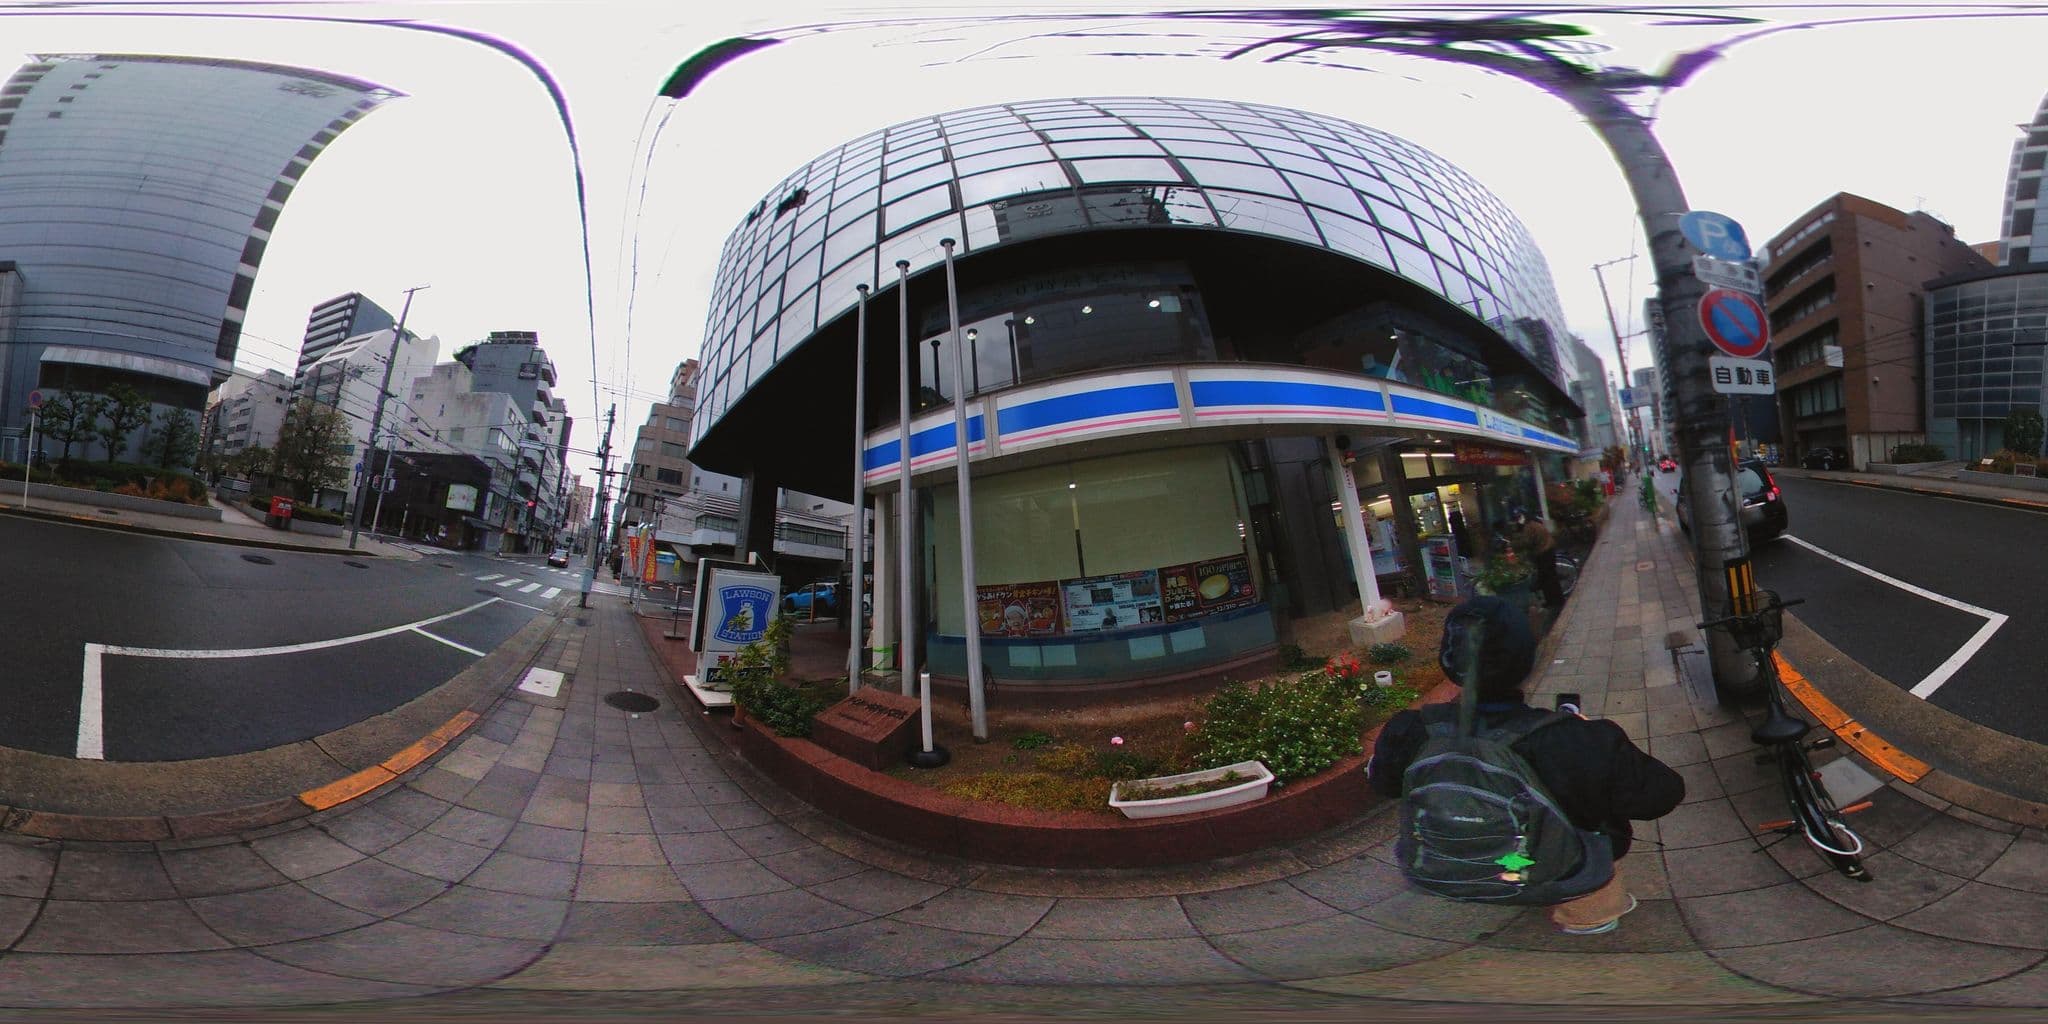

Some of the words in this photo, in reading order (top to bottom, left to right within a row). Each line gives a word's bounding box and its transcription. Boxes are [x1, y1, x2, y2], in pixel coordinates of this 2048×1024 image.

[1698, 219, 1728, 249] P
[1715, 366, 1771, 386] 自動車
[725, 589, 770, 602] LAWSON
